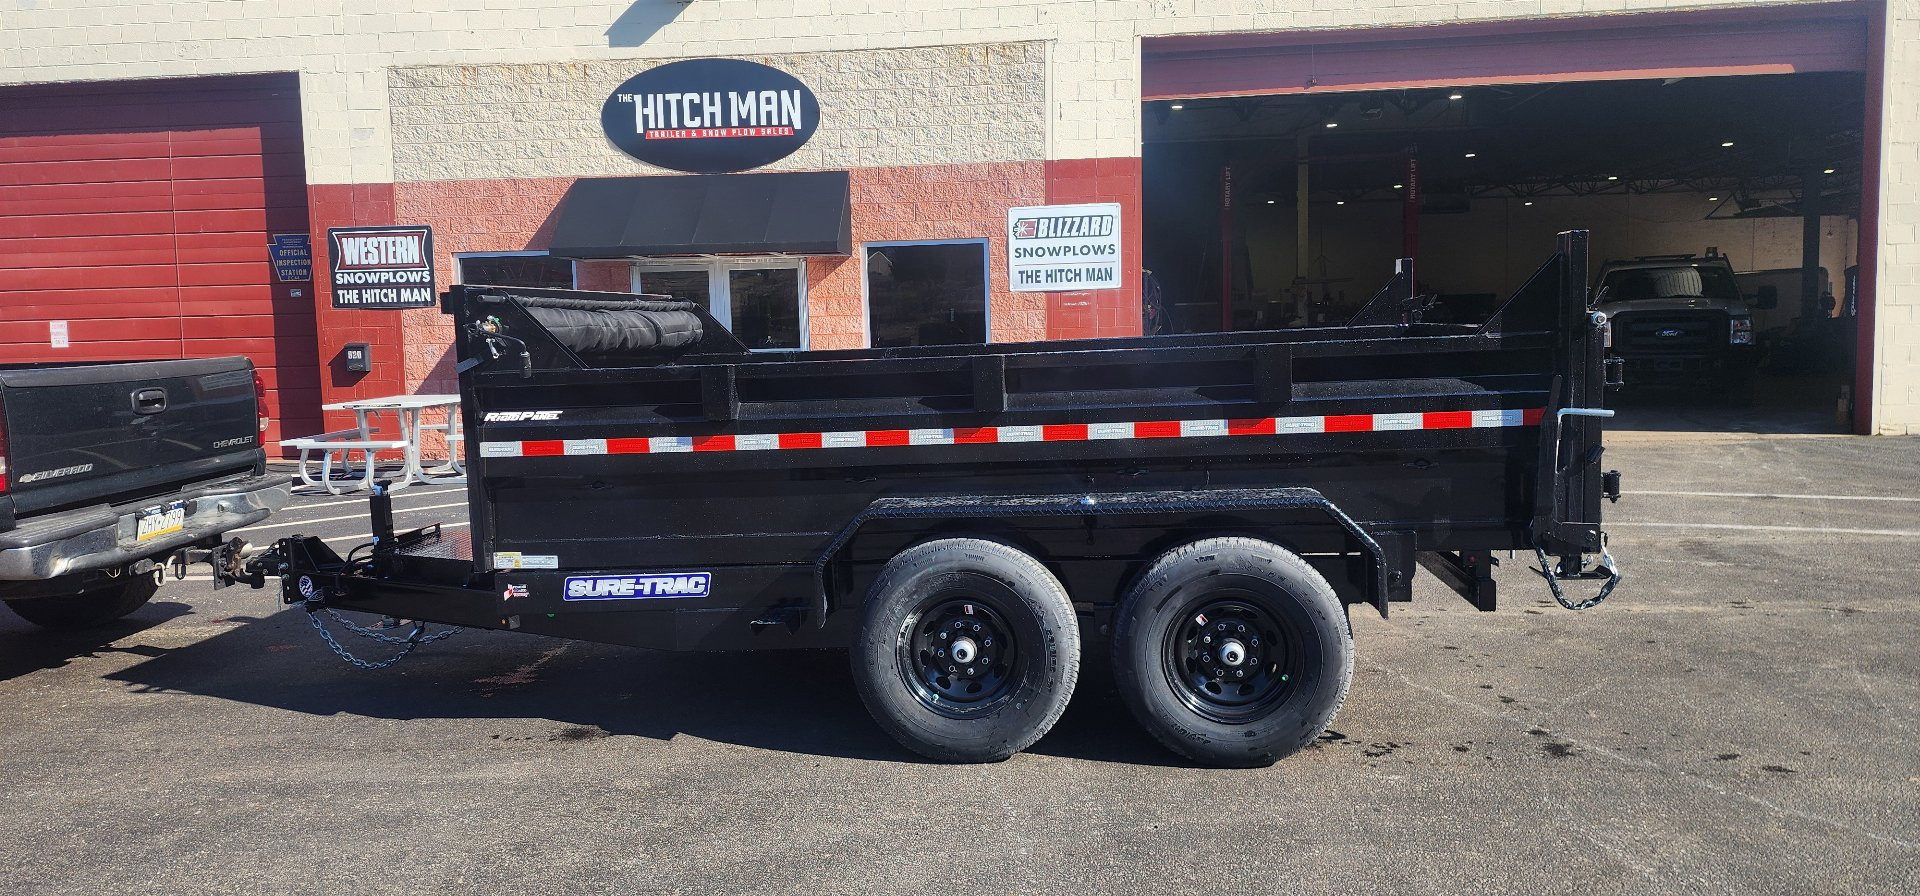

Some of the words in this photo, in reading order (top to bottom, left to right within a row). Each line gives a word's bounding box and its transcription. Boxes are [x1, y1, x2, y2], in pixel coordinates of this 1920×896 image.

[617, 93, 633, 102] THE
[633, 91, 722, 134] HITCH
[728, 89, 802, 130] MAN
[648, 130, 686, 138] TRAILER
[691, 129, 697, 137] &
[702, 129, 727, 137] SNOW
[732, 128, 756, 136] PLOW
[761, 127, 789, 135] SALES
[1037, 216, 1113, 238] BLIZZARD
[342, 236, 420, 265] WESTERN
[1014, 244, 1116, 258] SNOWPLOWS
[335, 271, 431, 285] SNOWPLOWS
[1018, 270, 1041, 284] THE
[1045, 268, 1081, 283] HITCH
[1086, 267, 1113, 282] MAN
[338, 289, 360, 304] THE
[362, 288, 397, 304] HITCH
[400, 287, 431, 302] MAN
[213, 435, 253, 448] CHEVROLET
[568, 577, 706, 597] SURE-TRAC
